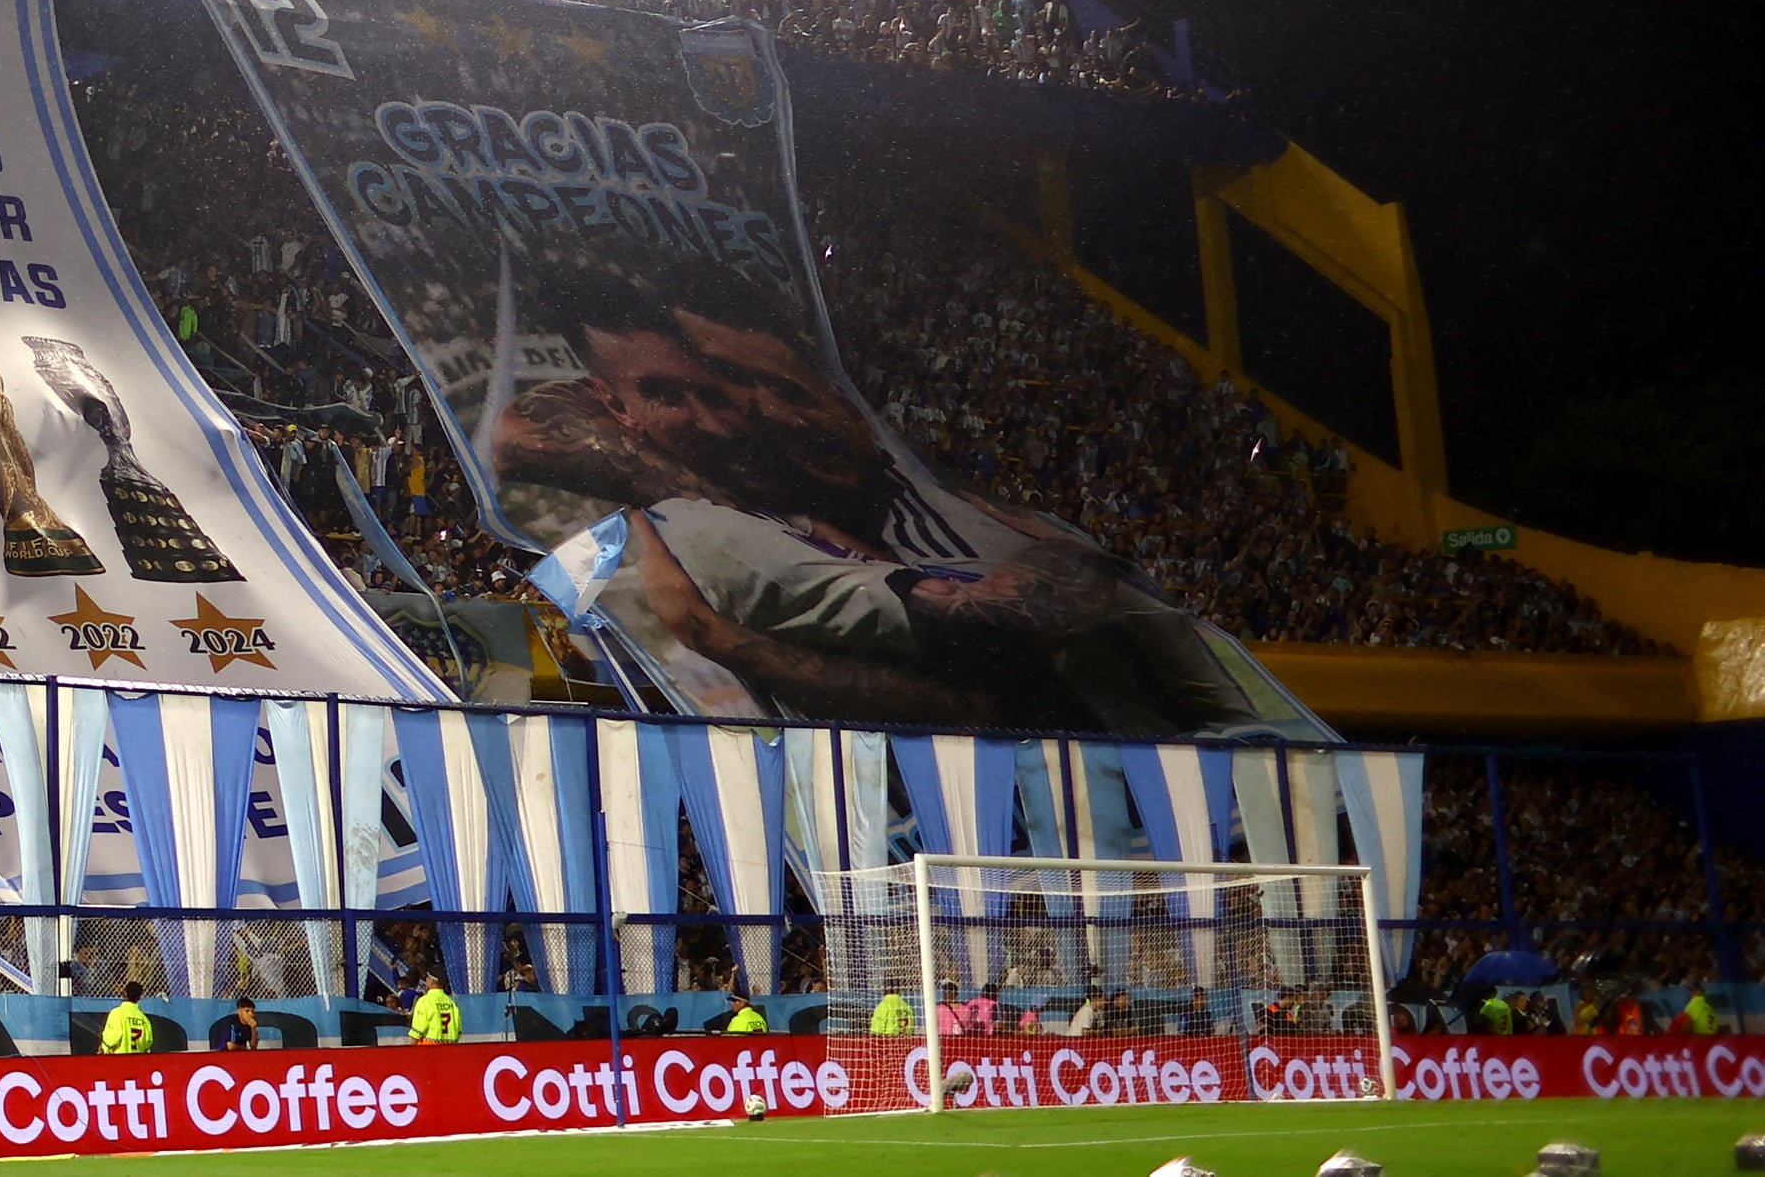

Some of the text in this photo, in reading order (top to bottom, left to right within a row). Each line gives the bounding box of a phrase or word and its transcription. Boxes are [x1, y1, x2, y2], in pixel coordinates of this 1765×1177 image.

[375, 101, 707, 204] GRACIAS
[348, 161, 790, 278] CAMPEONES
[5, 546, 73, 559] WORLD CUP
[9, 538, 59, 550] FIFA
[1448, 531, 1493, 548] Salida
[61, 623, 147, 652] 2022
[181, 627, 277, 655] 2024
[484, 1049, 850, 1120] Cotti Coffee
[905, 1047, 1221, 1108] Cotti Coffee
[1249, 1046, 1540, 1101] Cotti Coffee
[1583, 1045, 1701, 1098] Cotti
[187, 1064, 417, 1136] Coffee
